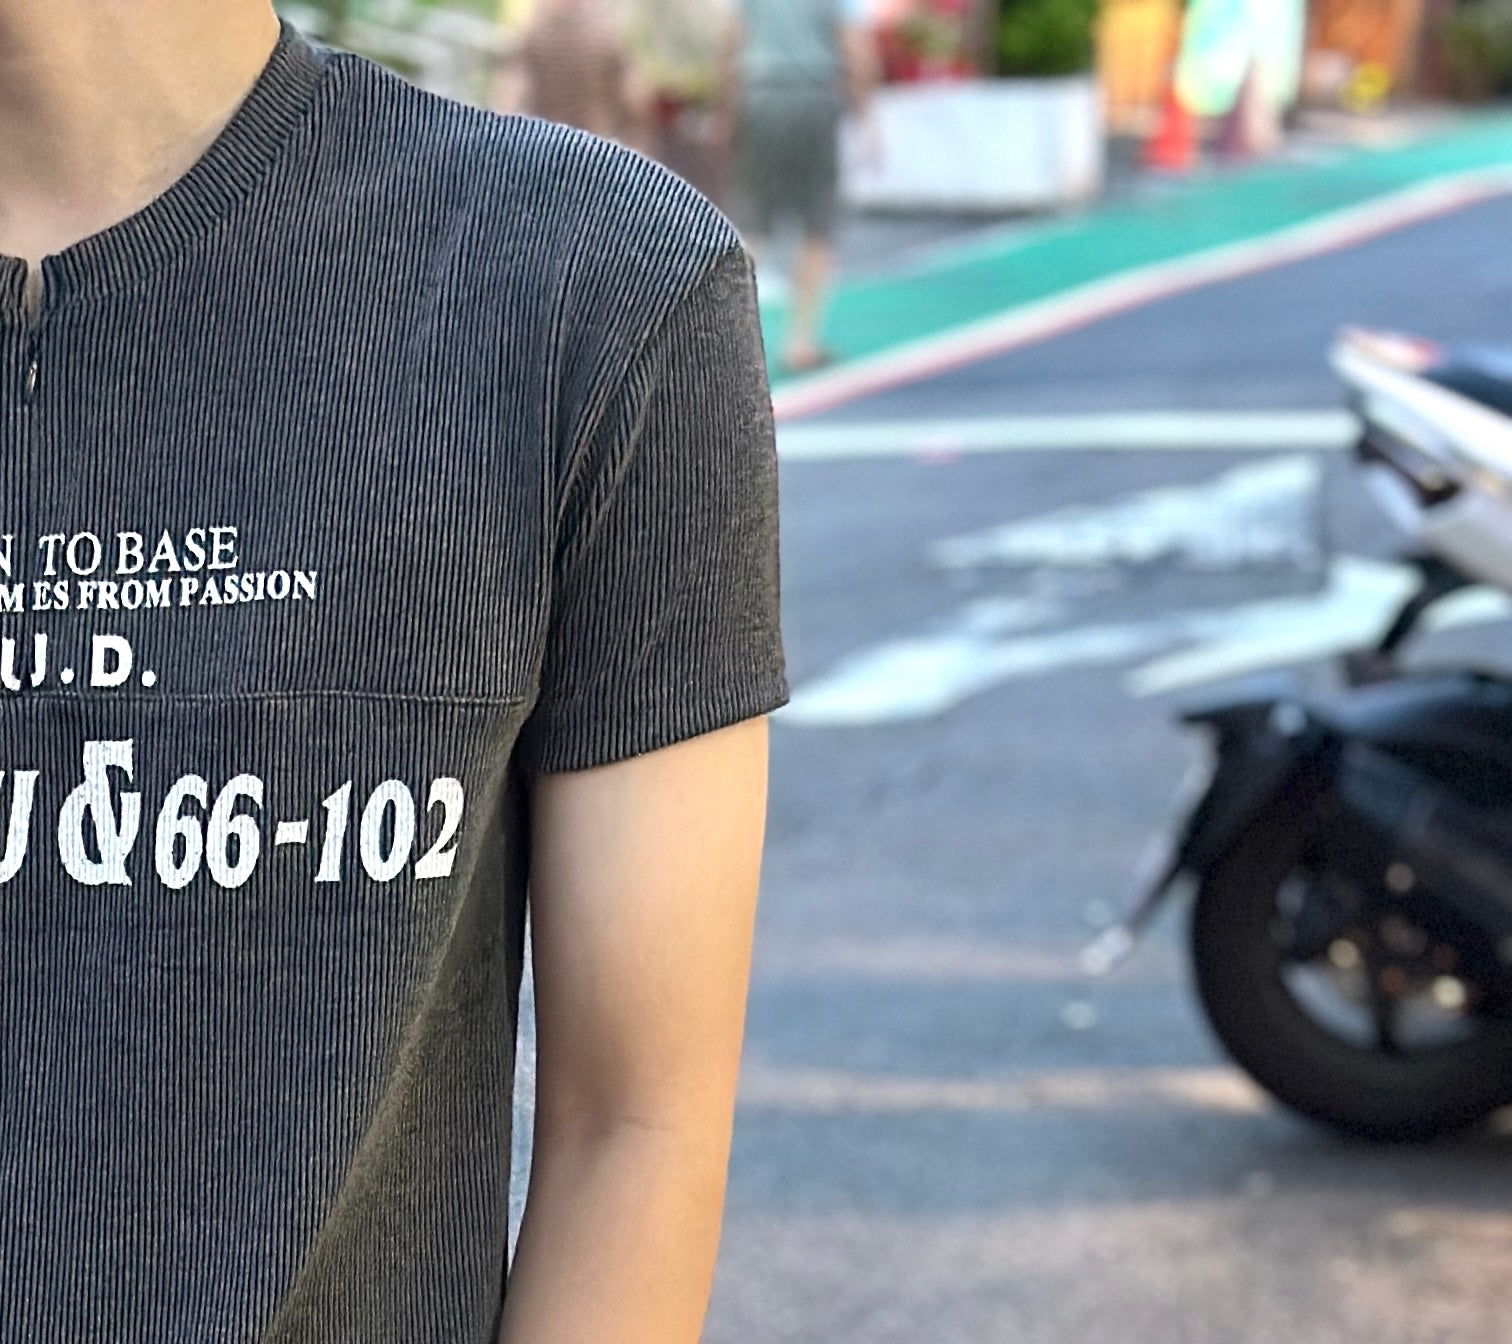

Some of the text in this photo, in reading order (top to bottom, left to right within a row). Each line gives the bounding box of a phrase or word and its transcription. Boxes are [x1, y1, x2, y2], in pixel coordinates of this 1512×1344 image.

[37, 531, 103, 577] TO
[115, 526, 239, 576] BASE
[76, 578, 172, 610] FROM
[178, 570, 318, 607] PASSION
[153, 773, 465, 890] 66-102
